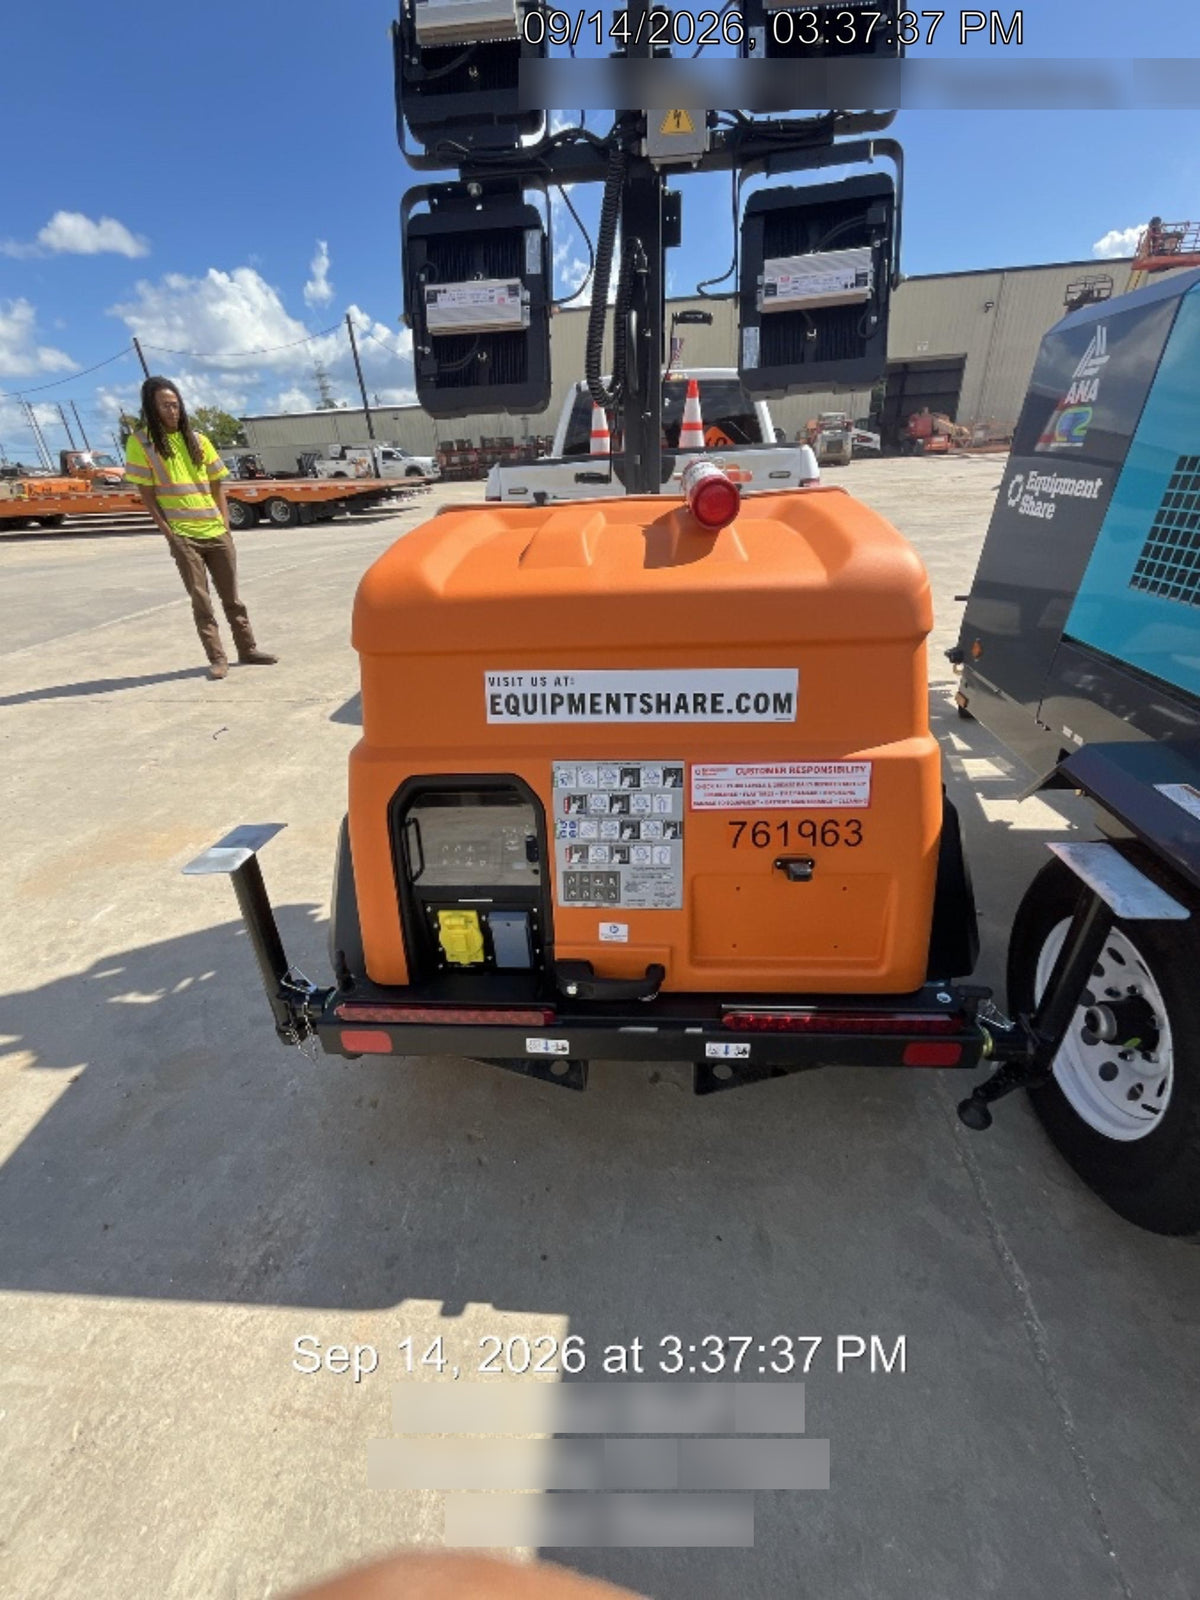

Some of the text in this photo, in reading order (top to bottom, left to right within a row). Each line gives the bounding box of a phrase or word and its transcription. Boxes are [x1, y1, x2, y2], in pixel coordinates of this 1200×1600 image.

[1064, 378, 1100, 404] ANA
[1026, 470, 1103, 499] Equipment
[1018, 493, 1056, 520] Share
[488, 676, 575, 687] VISIT US AT:
[489, 692, 793, 716] EQUIPMENTSHARE.COM
[735, 766, 786, 776] CUSTOMER
[789, 765, 866, 775] RESPONSIBILITY
[728, 818, 864, 849] 761963
